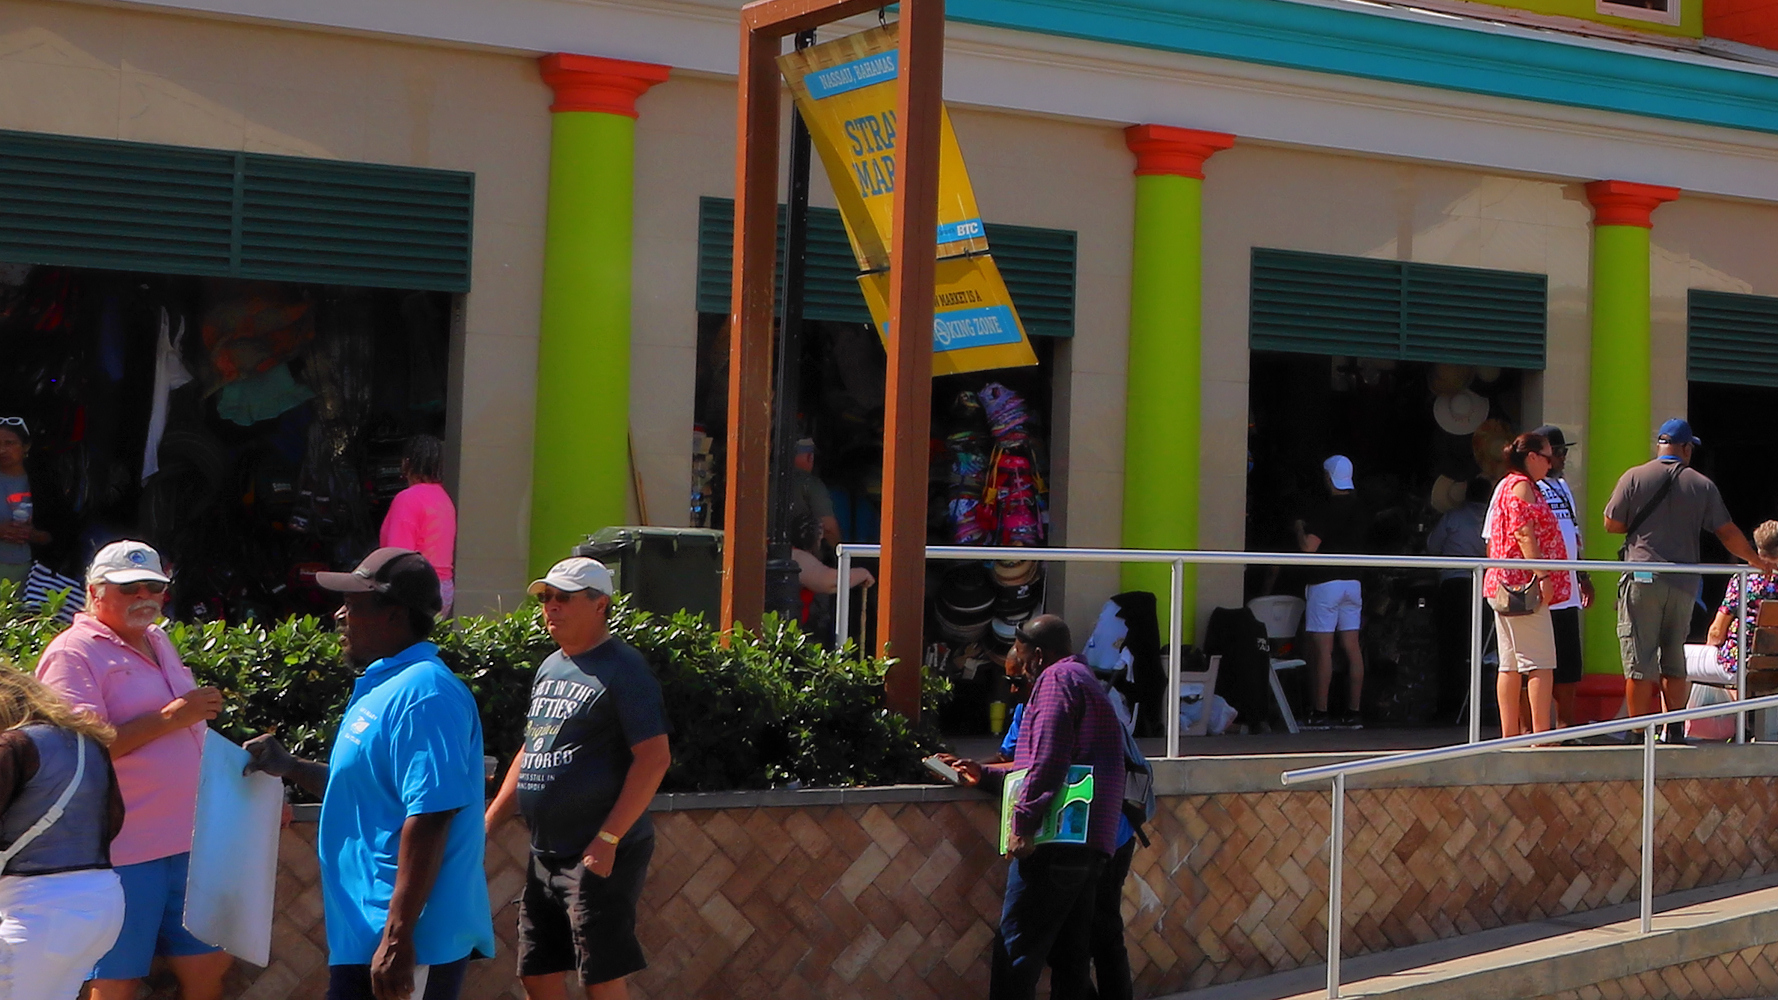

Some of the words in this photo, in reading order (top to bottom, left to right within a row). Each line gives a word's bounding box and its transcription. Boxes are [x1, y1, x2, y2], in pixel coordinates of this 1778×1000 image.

[819, 66, 857, 90] NASSAU,
[854, 56, 895, 81] BAHAMAS
[844, 109, 898, 157] STRA
[956, 222, 979, 237] BTC
[939, 290, 967, 307] MARKET
[966, 289, 976, 304] IS
[974, 289, 982, 302] A
[973, 315, 1003, 336] ZONE
[554, 680, 568, 696] IN
[567, 680, 596, 704] THE
